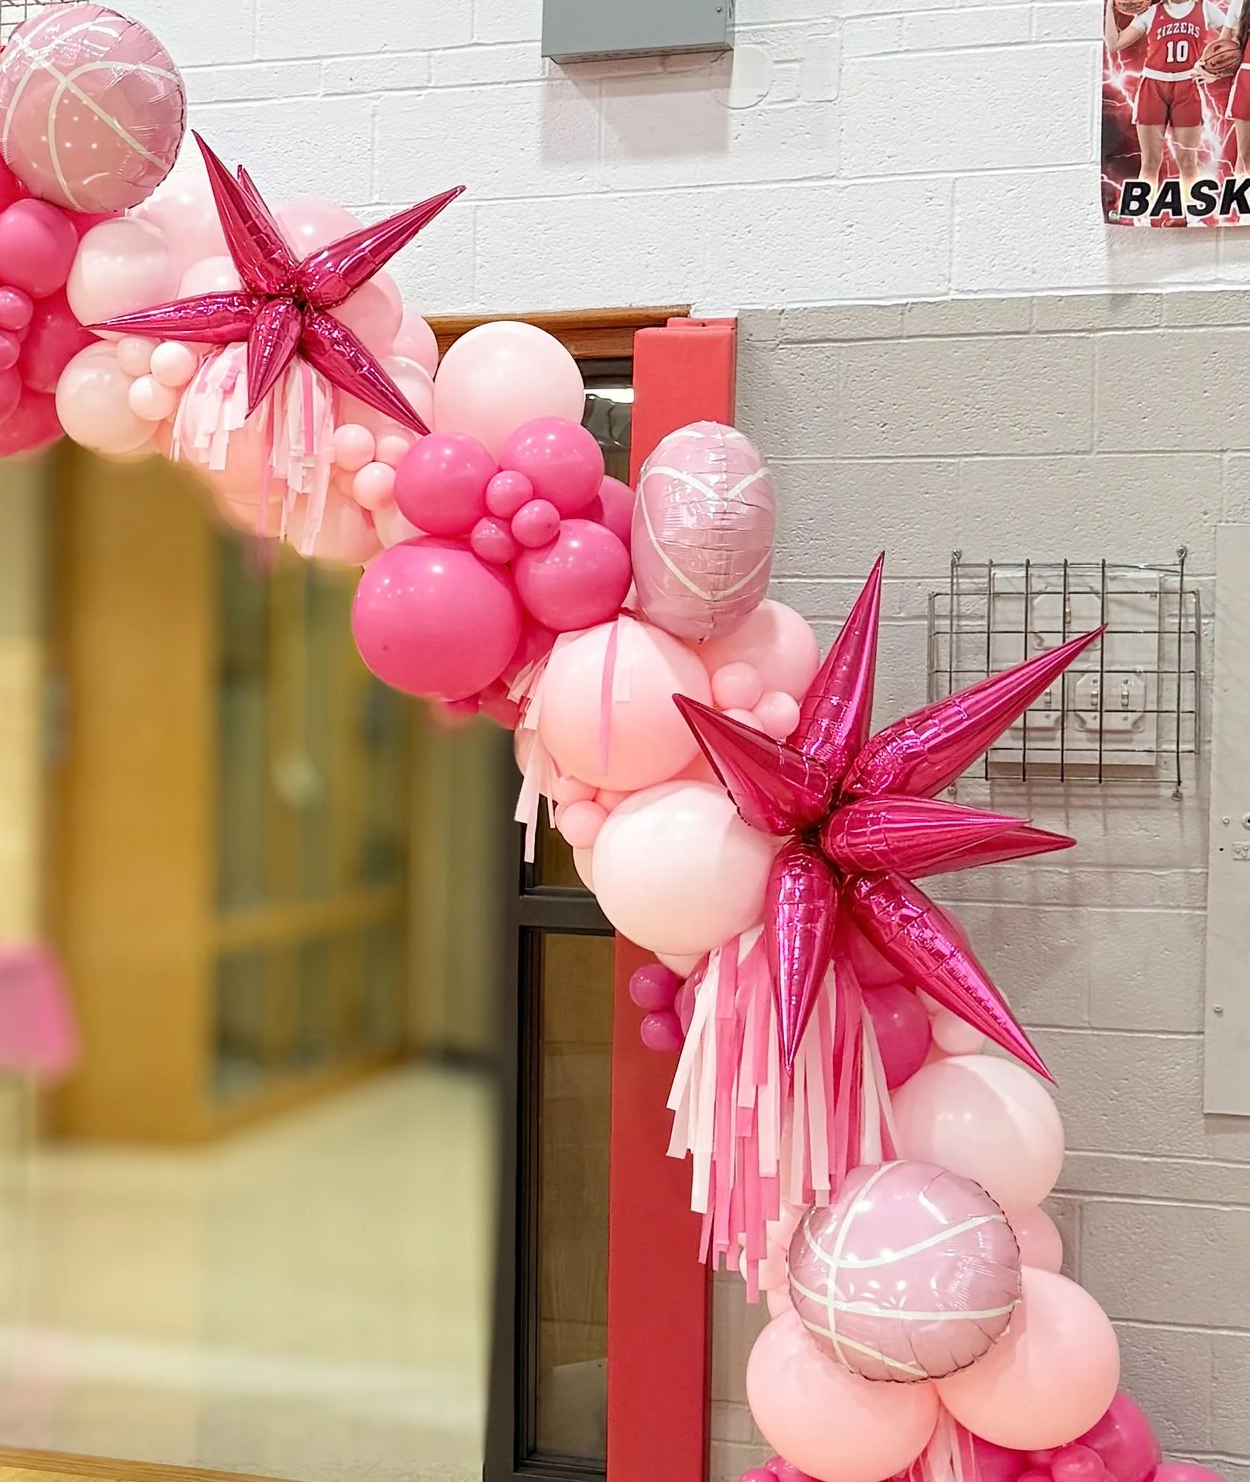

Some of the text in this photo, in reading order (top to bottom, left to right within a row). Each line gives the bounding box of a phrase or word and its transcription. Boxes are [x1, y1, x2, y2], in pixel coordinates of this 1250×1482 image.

[1156, 21, 1201, 40] ZIZZERS
[1165, 39, 1190, 64] 10
[1118, 177, 1250, 219] BASK
